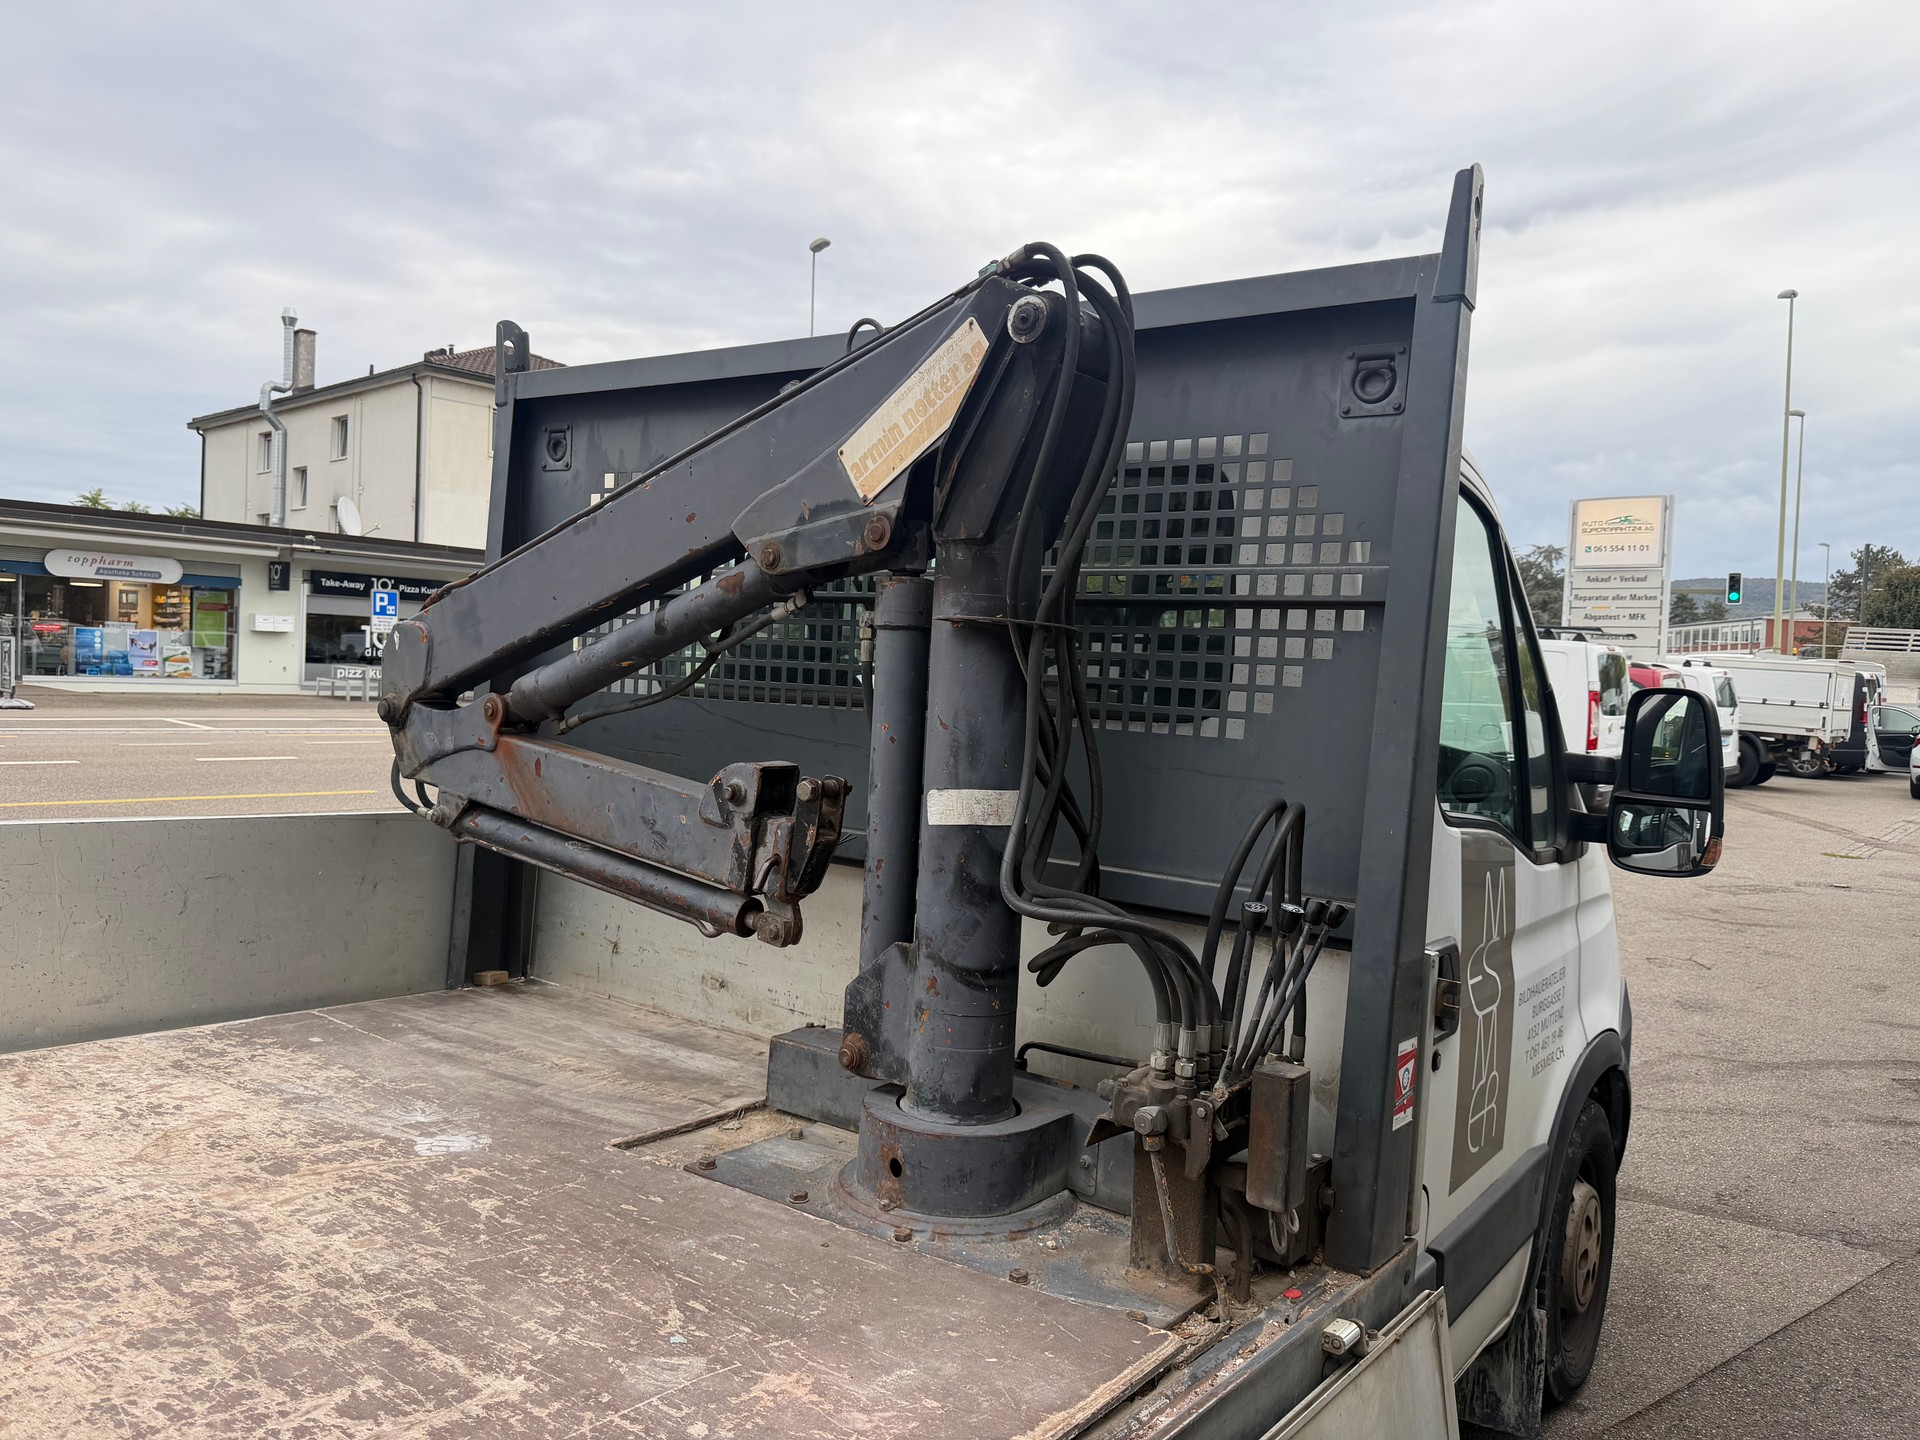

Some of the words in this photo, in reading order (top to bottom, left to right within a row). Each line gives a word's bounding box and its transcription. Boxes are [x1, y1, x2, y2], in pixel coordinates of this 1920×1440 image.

[850, 422, 904, 481] armin
[902, 363, 960, 431] notter
[961, 339, 985, 374] ag
[67, 556, 134, 567] toppharm
[99, 568, 130, 577] Apotheke
[320, 578, 365, 590] Take-Away
[399, 584, 420, 594] Pizza
[375, 593, 388, 612] P
[1573, 594, 1609, 602] Reparatur
[1583, 613, 1620, 621] Abgastest
[337, 667, 363, 679] pizz
[1518, 966, 1566, 1007] BILDHAUERATELIER
[1532, 988, 1562, 1019] BURGGASSE
[1562, 985, 1566, 999] 7
[1527, 1022, 1540, 1041] 4132
[1540, 1005, 1565, 1033] MUTTENZ
[1529, 1042, 1540, 1060] 061
